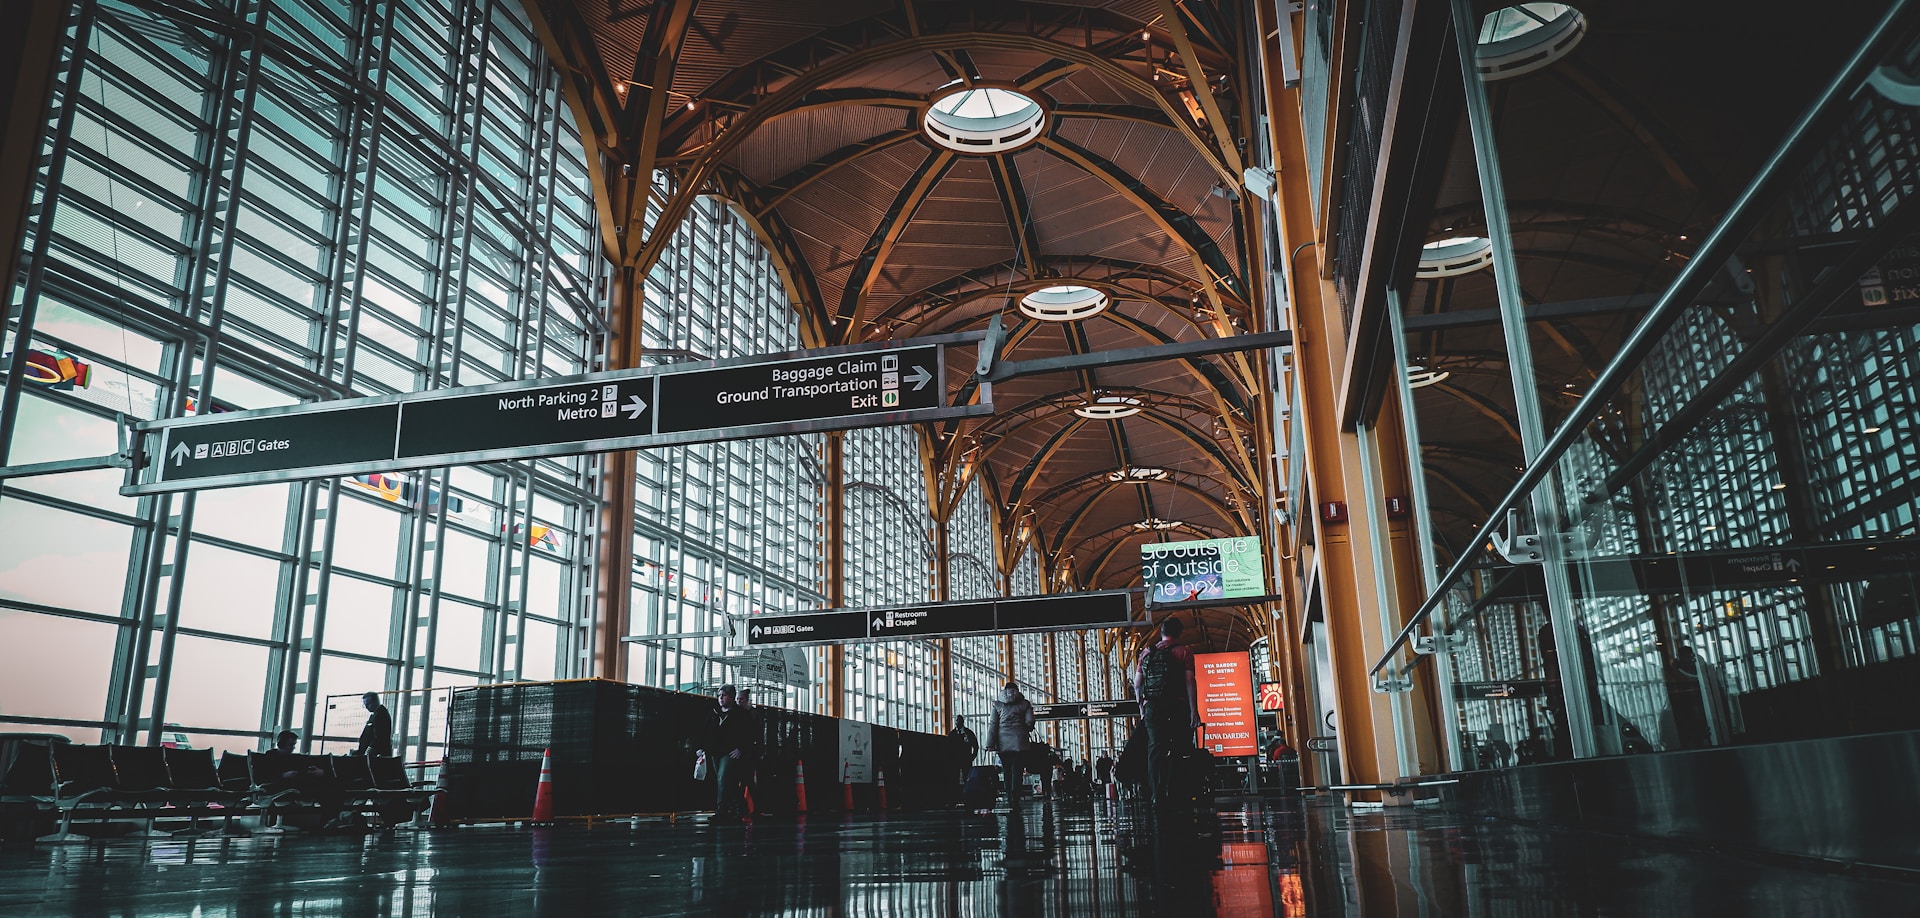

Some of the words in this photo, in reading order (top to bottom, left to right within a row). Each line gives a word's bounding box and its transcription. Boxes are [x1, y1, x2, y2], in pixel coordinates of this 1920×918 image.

[772, 366, 834, 383] Baggage
[837, 360, 877, 376] Claim
[498, 396, 535, 410] North
[538, 391, 587, 406] Parking
[590, 389, 598, 401] 2
[604, 387, 615, 399] P
[716, 386, 769, 404] Ground
[772, 378, 878, 399] Transportation
[851, 394, 878, 409] Exit
[557, 407, 598, 421] Metro
[604, 404, 615, 415] M
[257, 439, 290, 452] Gates
[1141, 543, 1168, 560] Go
[1173, 538, 1248, 558] outside
[1142, 561, 1159, 579] of
[1164, 557, 1239, 577] outside
[1181, 578, 1218, 595] box
[894, 611, 927, 619] Restrooms
[894, 618, 917, 627] Chapel
[796, 625, 814, 633] Gates
[1222, 732, 1250, 740] DARDEN
